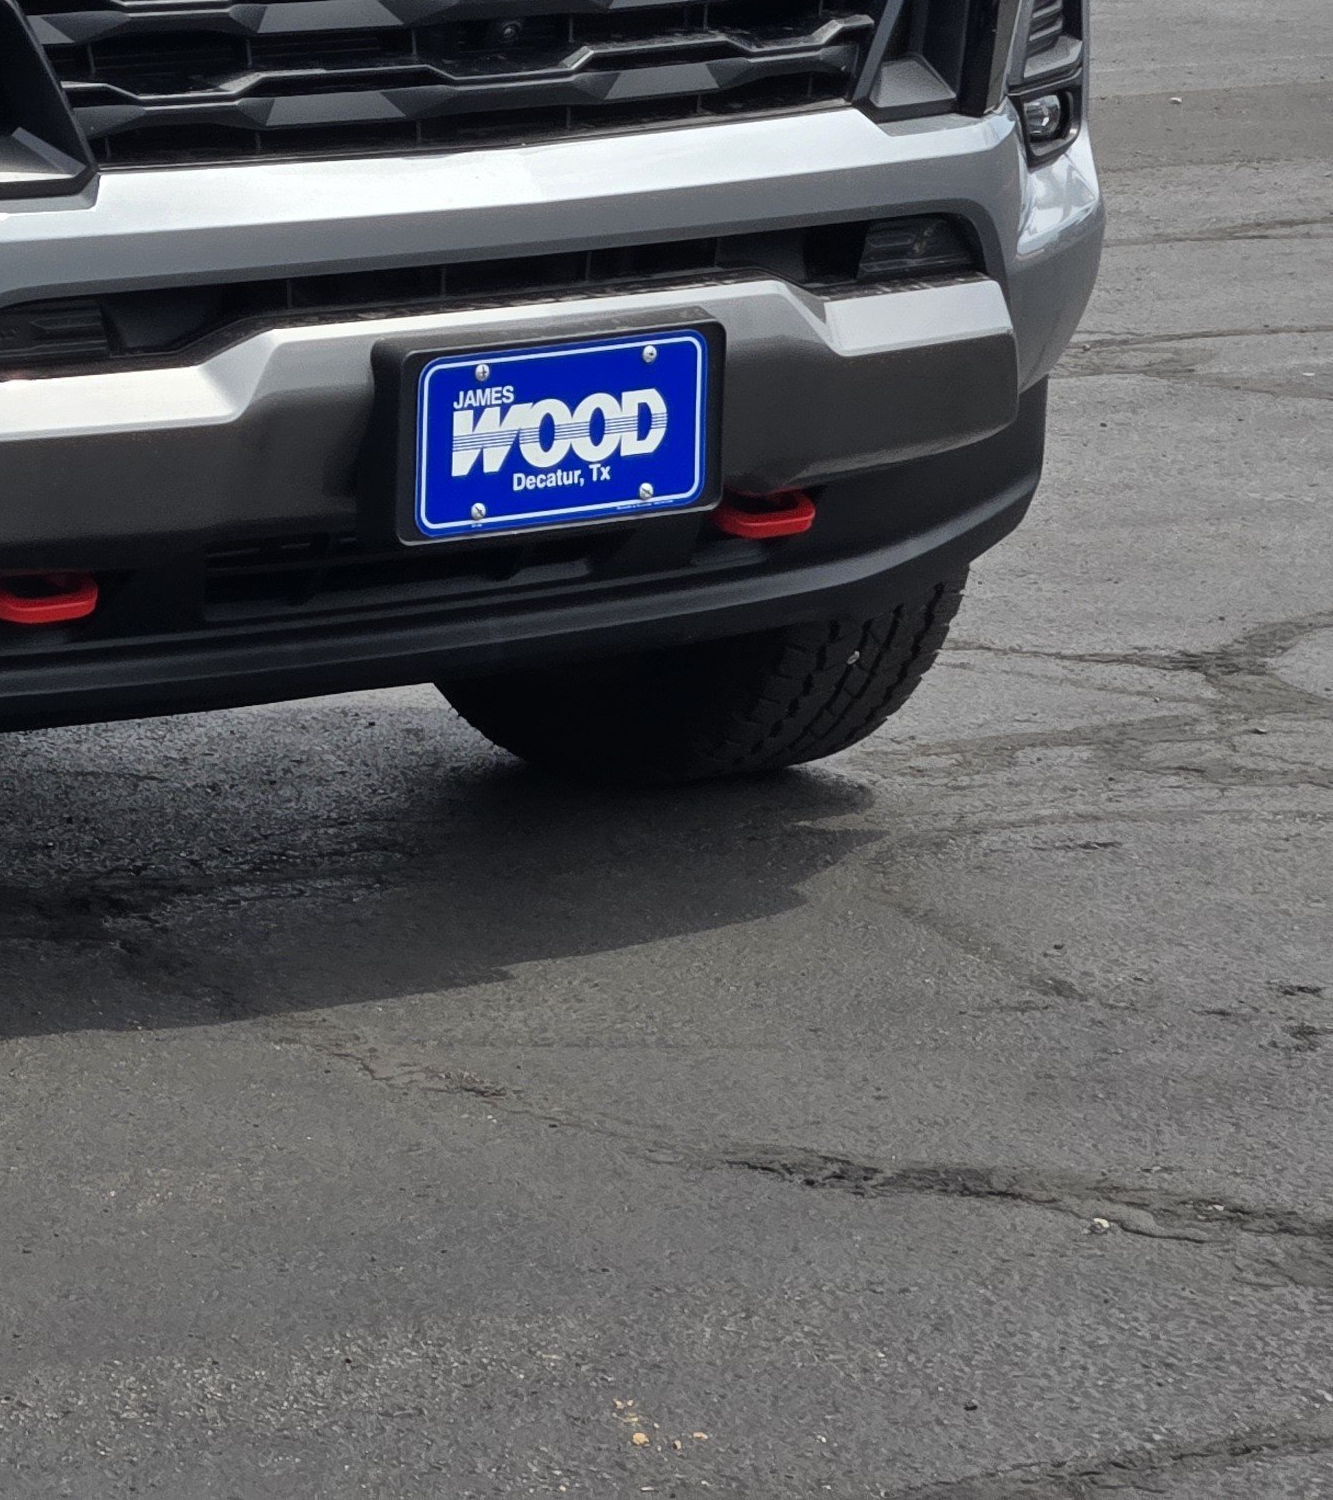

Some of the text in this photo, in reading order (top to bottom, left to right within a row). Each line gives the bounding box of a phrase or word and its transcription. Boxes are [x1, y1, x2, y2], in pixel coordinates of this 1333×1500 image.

[453, 385, 514, 409] JAMES
[451, 387, 668, 477] WOOD
[513, 463, 610, 491] Decatur, Tx
